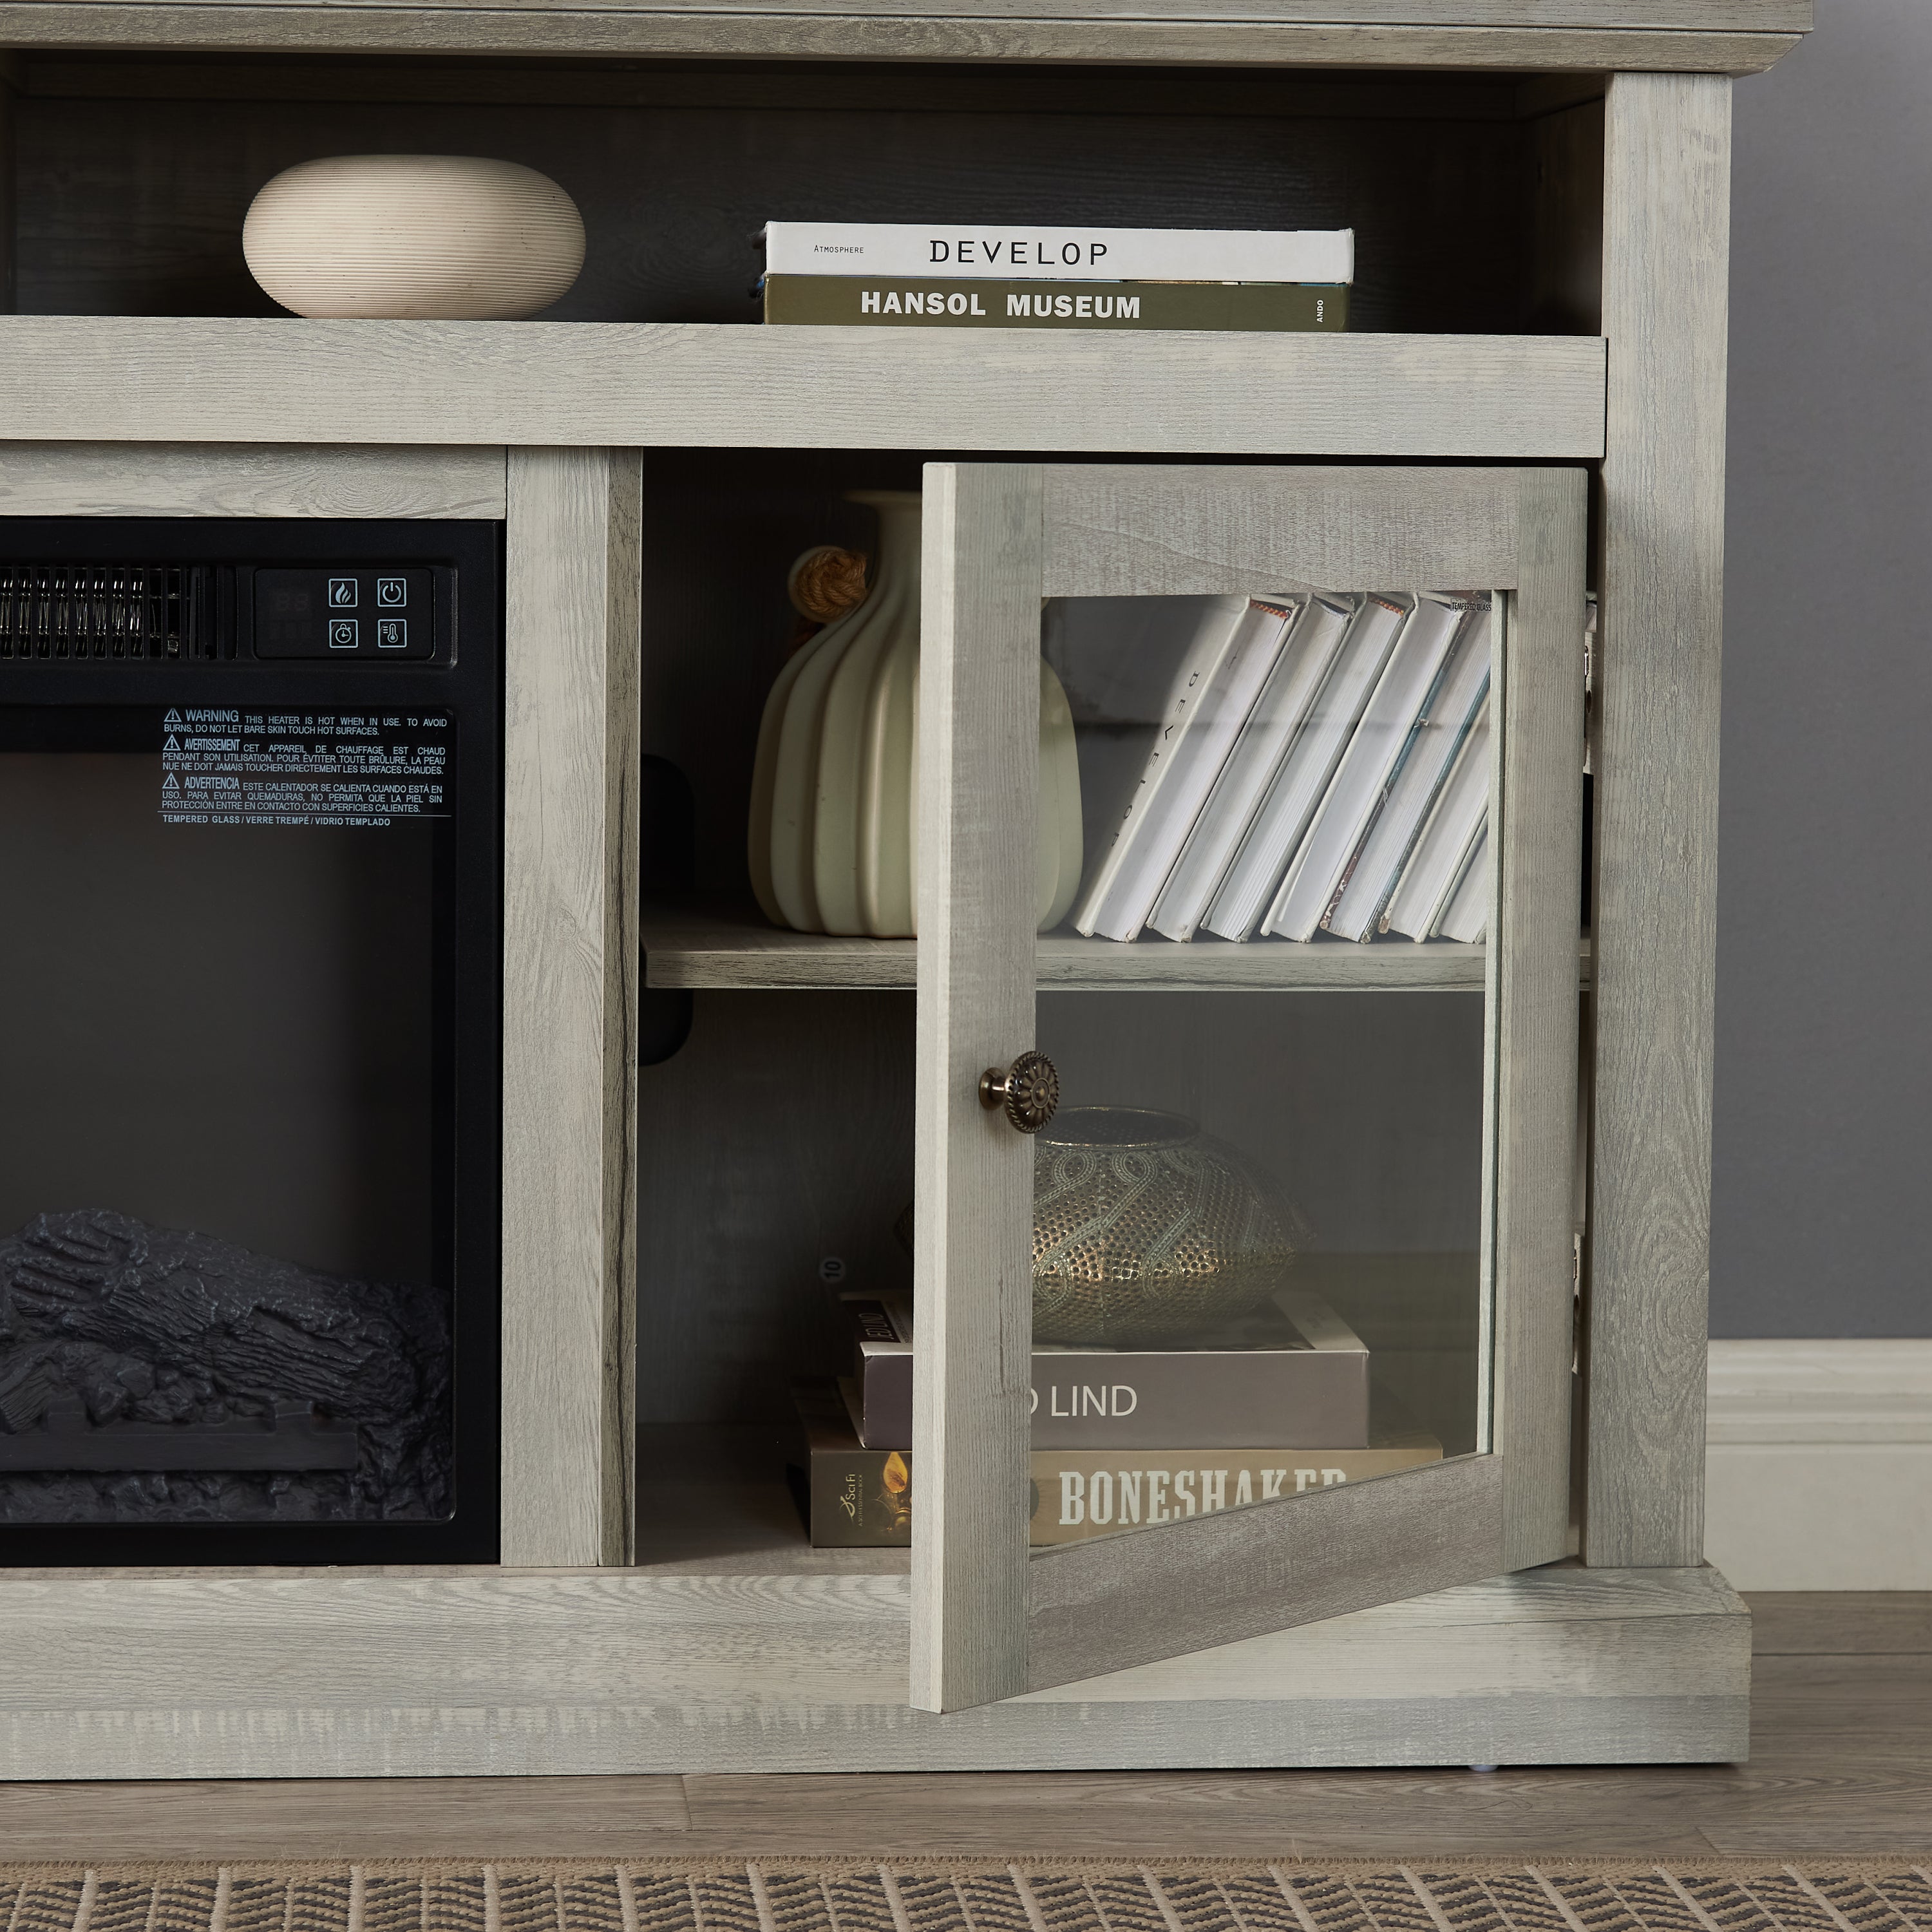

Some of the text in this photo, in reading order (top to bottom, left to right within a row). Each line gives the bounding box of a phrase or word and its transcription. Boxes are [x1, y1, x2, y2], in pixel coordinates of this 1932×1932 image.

[930, 240, 1108, 265] DEVELOP
[862, 290, 1140, 318] HANSOL MUSEUM
[1452, 602, 1475, 611] TEMPERED
[185, 709, 239, 722] WARNING
[245, 715, 263, 724] THIS
[269, 716, 299, 724] HEATER
[318, 717, 335, 725] HOT
[340, 717, 365, 726] WHEN
[370, 717, 378, 726] IN
[407, 718, 418, 726] TO
[423, 719, 447, 727] AVOID
[164, 724, 193, 734] BURNS,
[195, 724, 207, 733] DO
[209, 724, 226, 733] NOT
[244, 725, 265, 734] BARE
[288, 726, 316, 734] TOUCH
[336, 726, 379, 735] SURFACES.
[184, 738, 446, 755] AVERTISSEMENT CET APPAREIL DE CHAUFFAGE EST CHAUD
[162, 752, 200, 761] PENDANT
[204, 753, 221, 761] SON
[224, 753, 273, 762] UTILISATION.
[277, 754, 299, 762] POUR
[339, 755, 366, 764] TOUTE
[369, 754, 408, 765] BRÛLURE,
[411, 756, 421, 764] LA
[424, 757, 446, 765] PEAU
[162, 762, 444, 775] NUE NE DOIT JAMAIS TOUCHER DIRECTEMENT LES SURFACES CHAUDES.
[184, 776, 442, 793] ADVERTENCIA ESTE CALENTADOR SE CALIENTA CUANDO ESTÁ EN
[162, 791, 181, 799] USO.
[187, 791, 209, 800] PARA
[214, 791, 242, 800] EVITAR
[247, 792, 305, 802] QUEMADURAS,
[328, 793, 363, 802] PERMITA
[368, 794, 386, 802] QUE
[406, 795, 423, 803] PIEL
[429, 795, 442, 803] SIN
[162, 799, 214, 810] PROTECCIÓN
[216, 801, 243, 810] ENTRE
[257, 802, 301, 811] CONTACTO
[302, 802, 320, 811] CON
[321, 803, 374, 812] SUPERFICIES
[375, 804, 421, 813] CALIENTES.
[162, 815, 208, 823] TEMPERED
[212, 815, 240, 824] GLASS
[245, 816, 274, 824] VERRE
[276, 815, 309, 825] TREMPÉ
[824, 1261, 841, 1278] 10
[1051, 1385, 1137, 1417] LIND
[1059, 1468, 1347, 1526] BONESHAK
